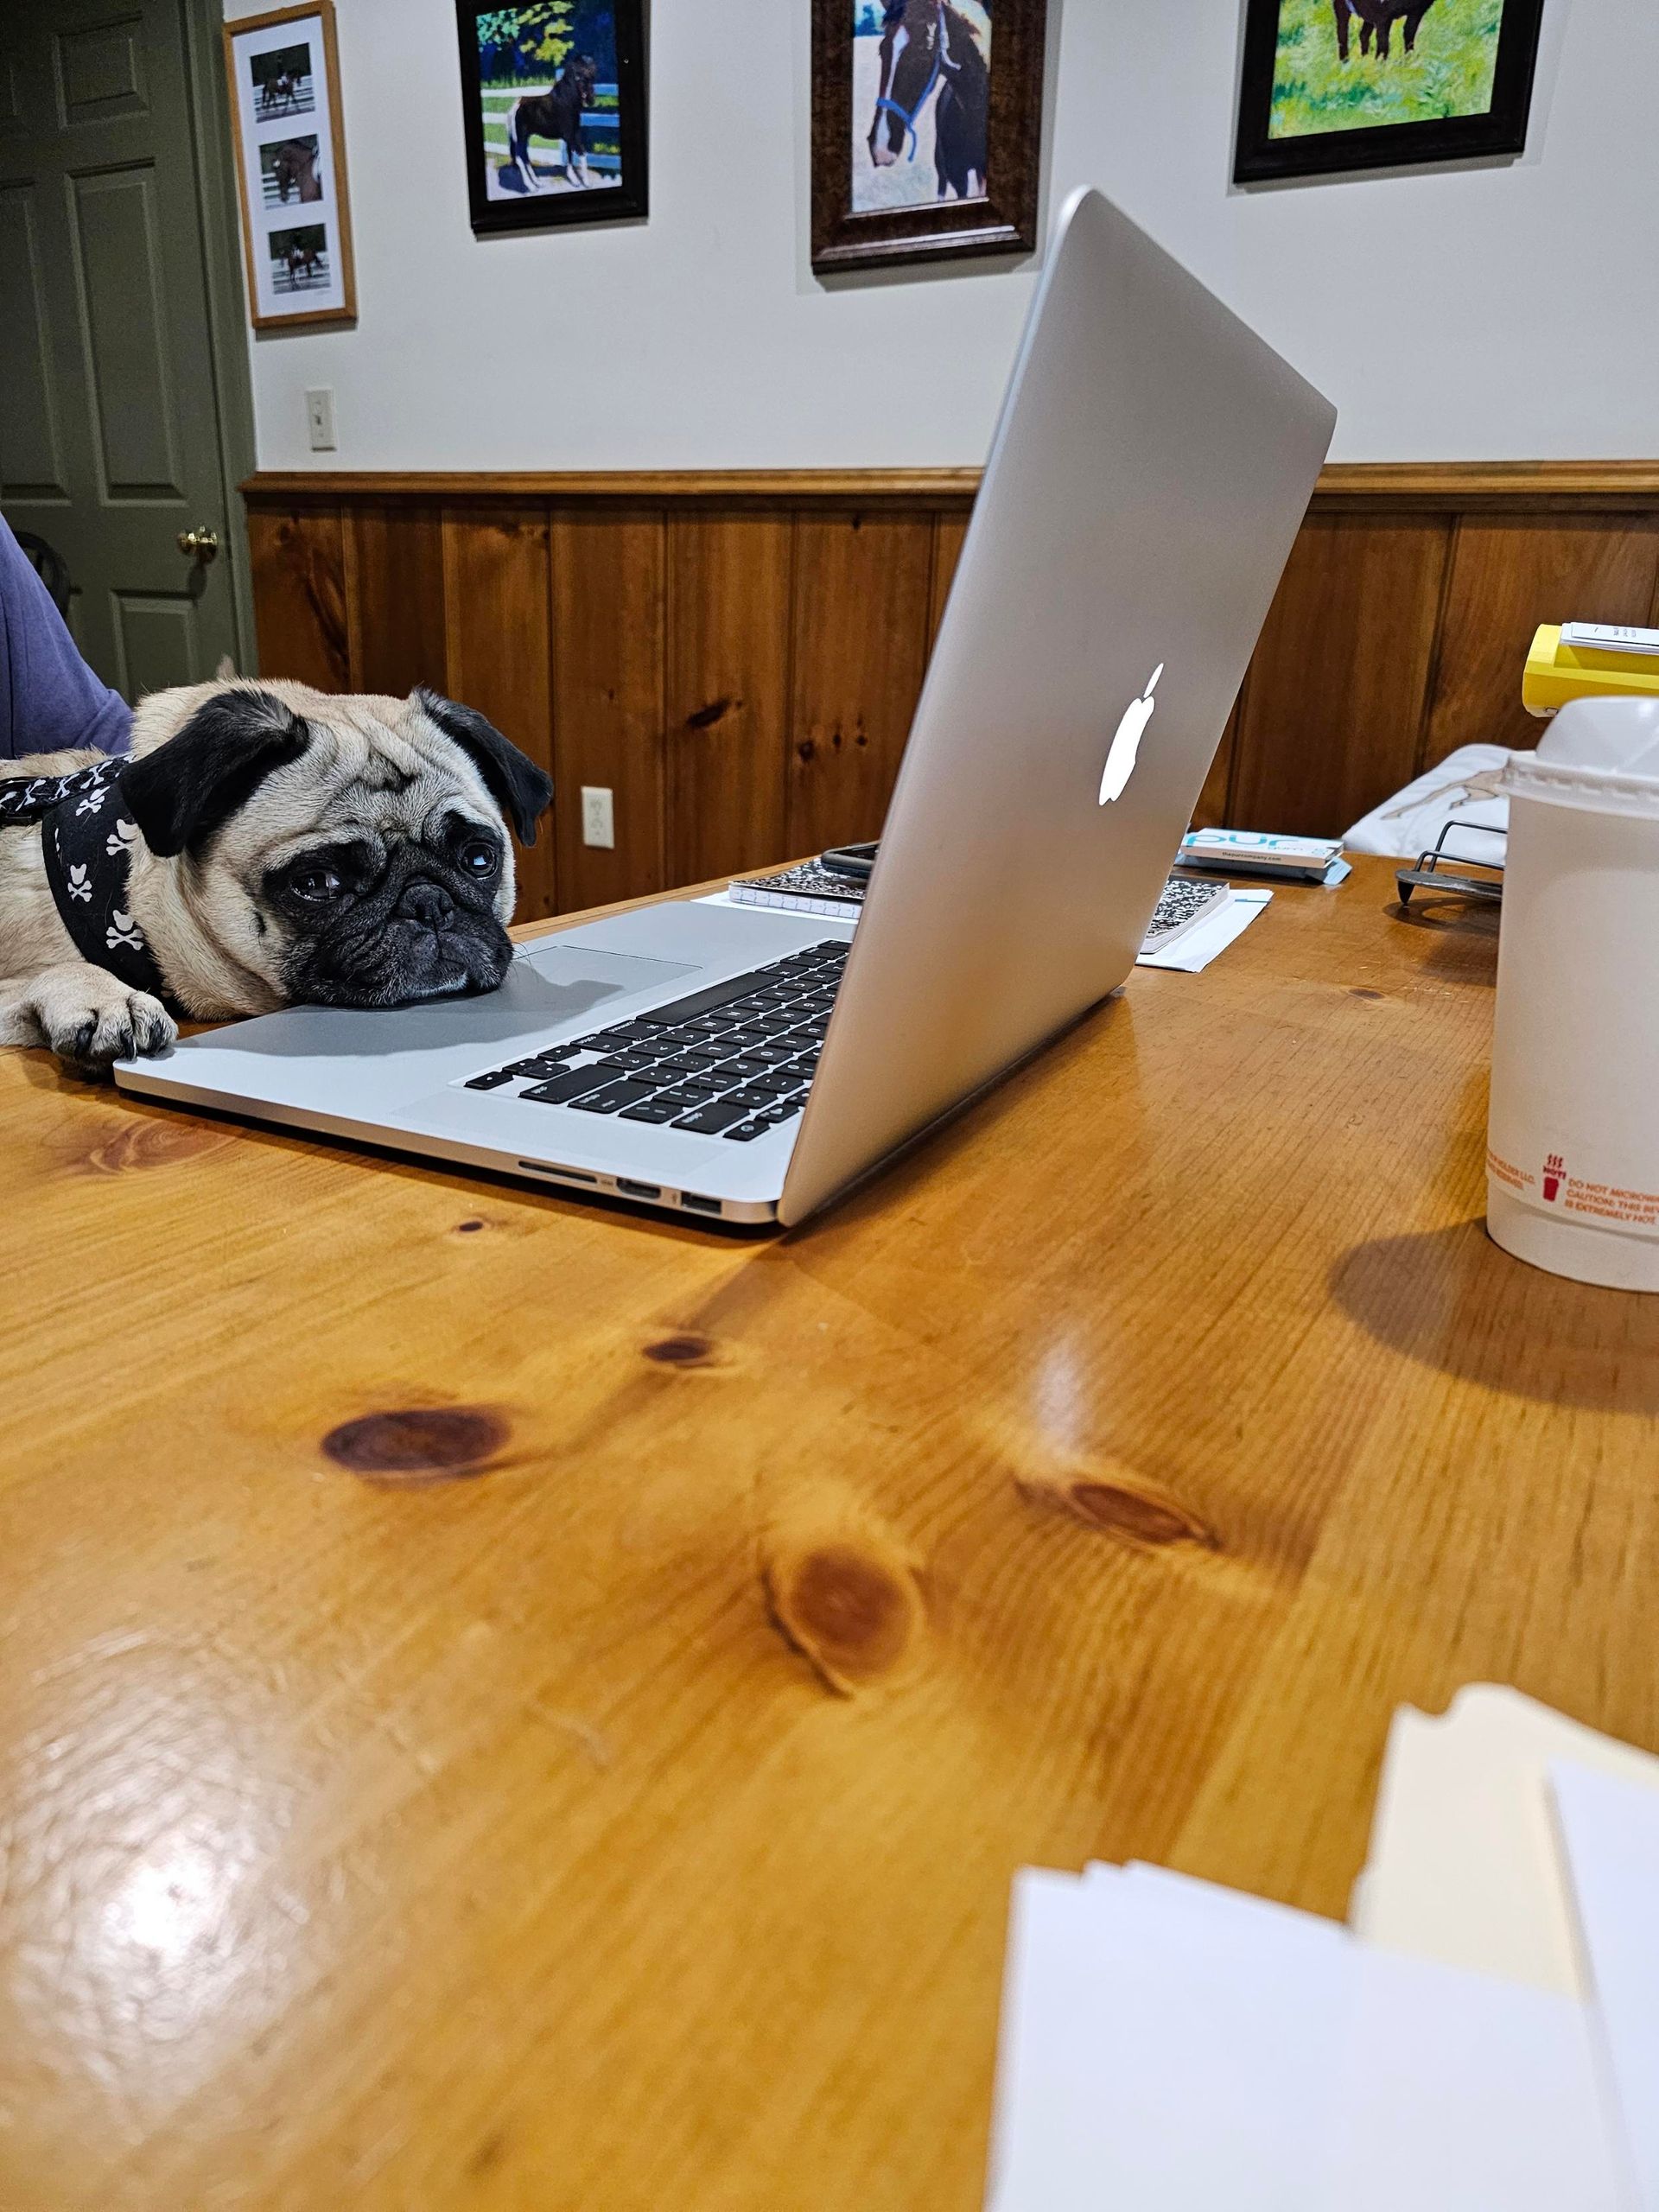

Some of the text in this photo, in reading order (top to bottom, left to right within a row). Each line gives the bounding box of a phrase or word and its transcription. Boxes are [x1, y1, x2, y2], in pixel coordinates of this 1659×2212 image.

[1568, 1178, 1584, 1189] DO
[1586, 1183, 1607, 1195] NOT
[1565, 1199, 1573, 1208] IS
[1575, 1202, 1631, 1221] EXTREMELY
[1618, 1200, 1640, 1211] THIS
